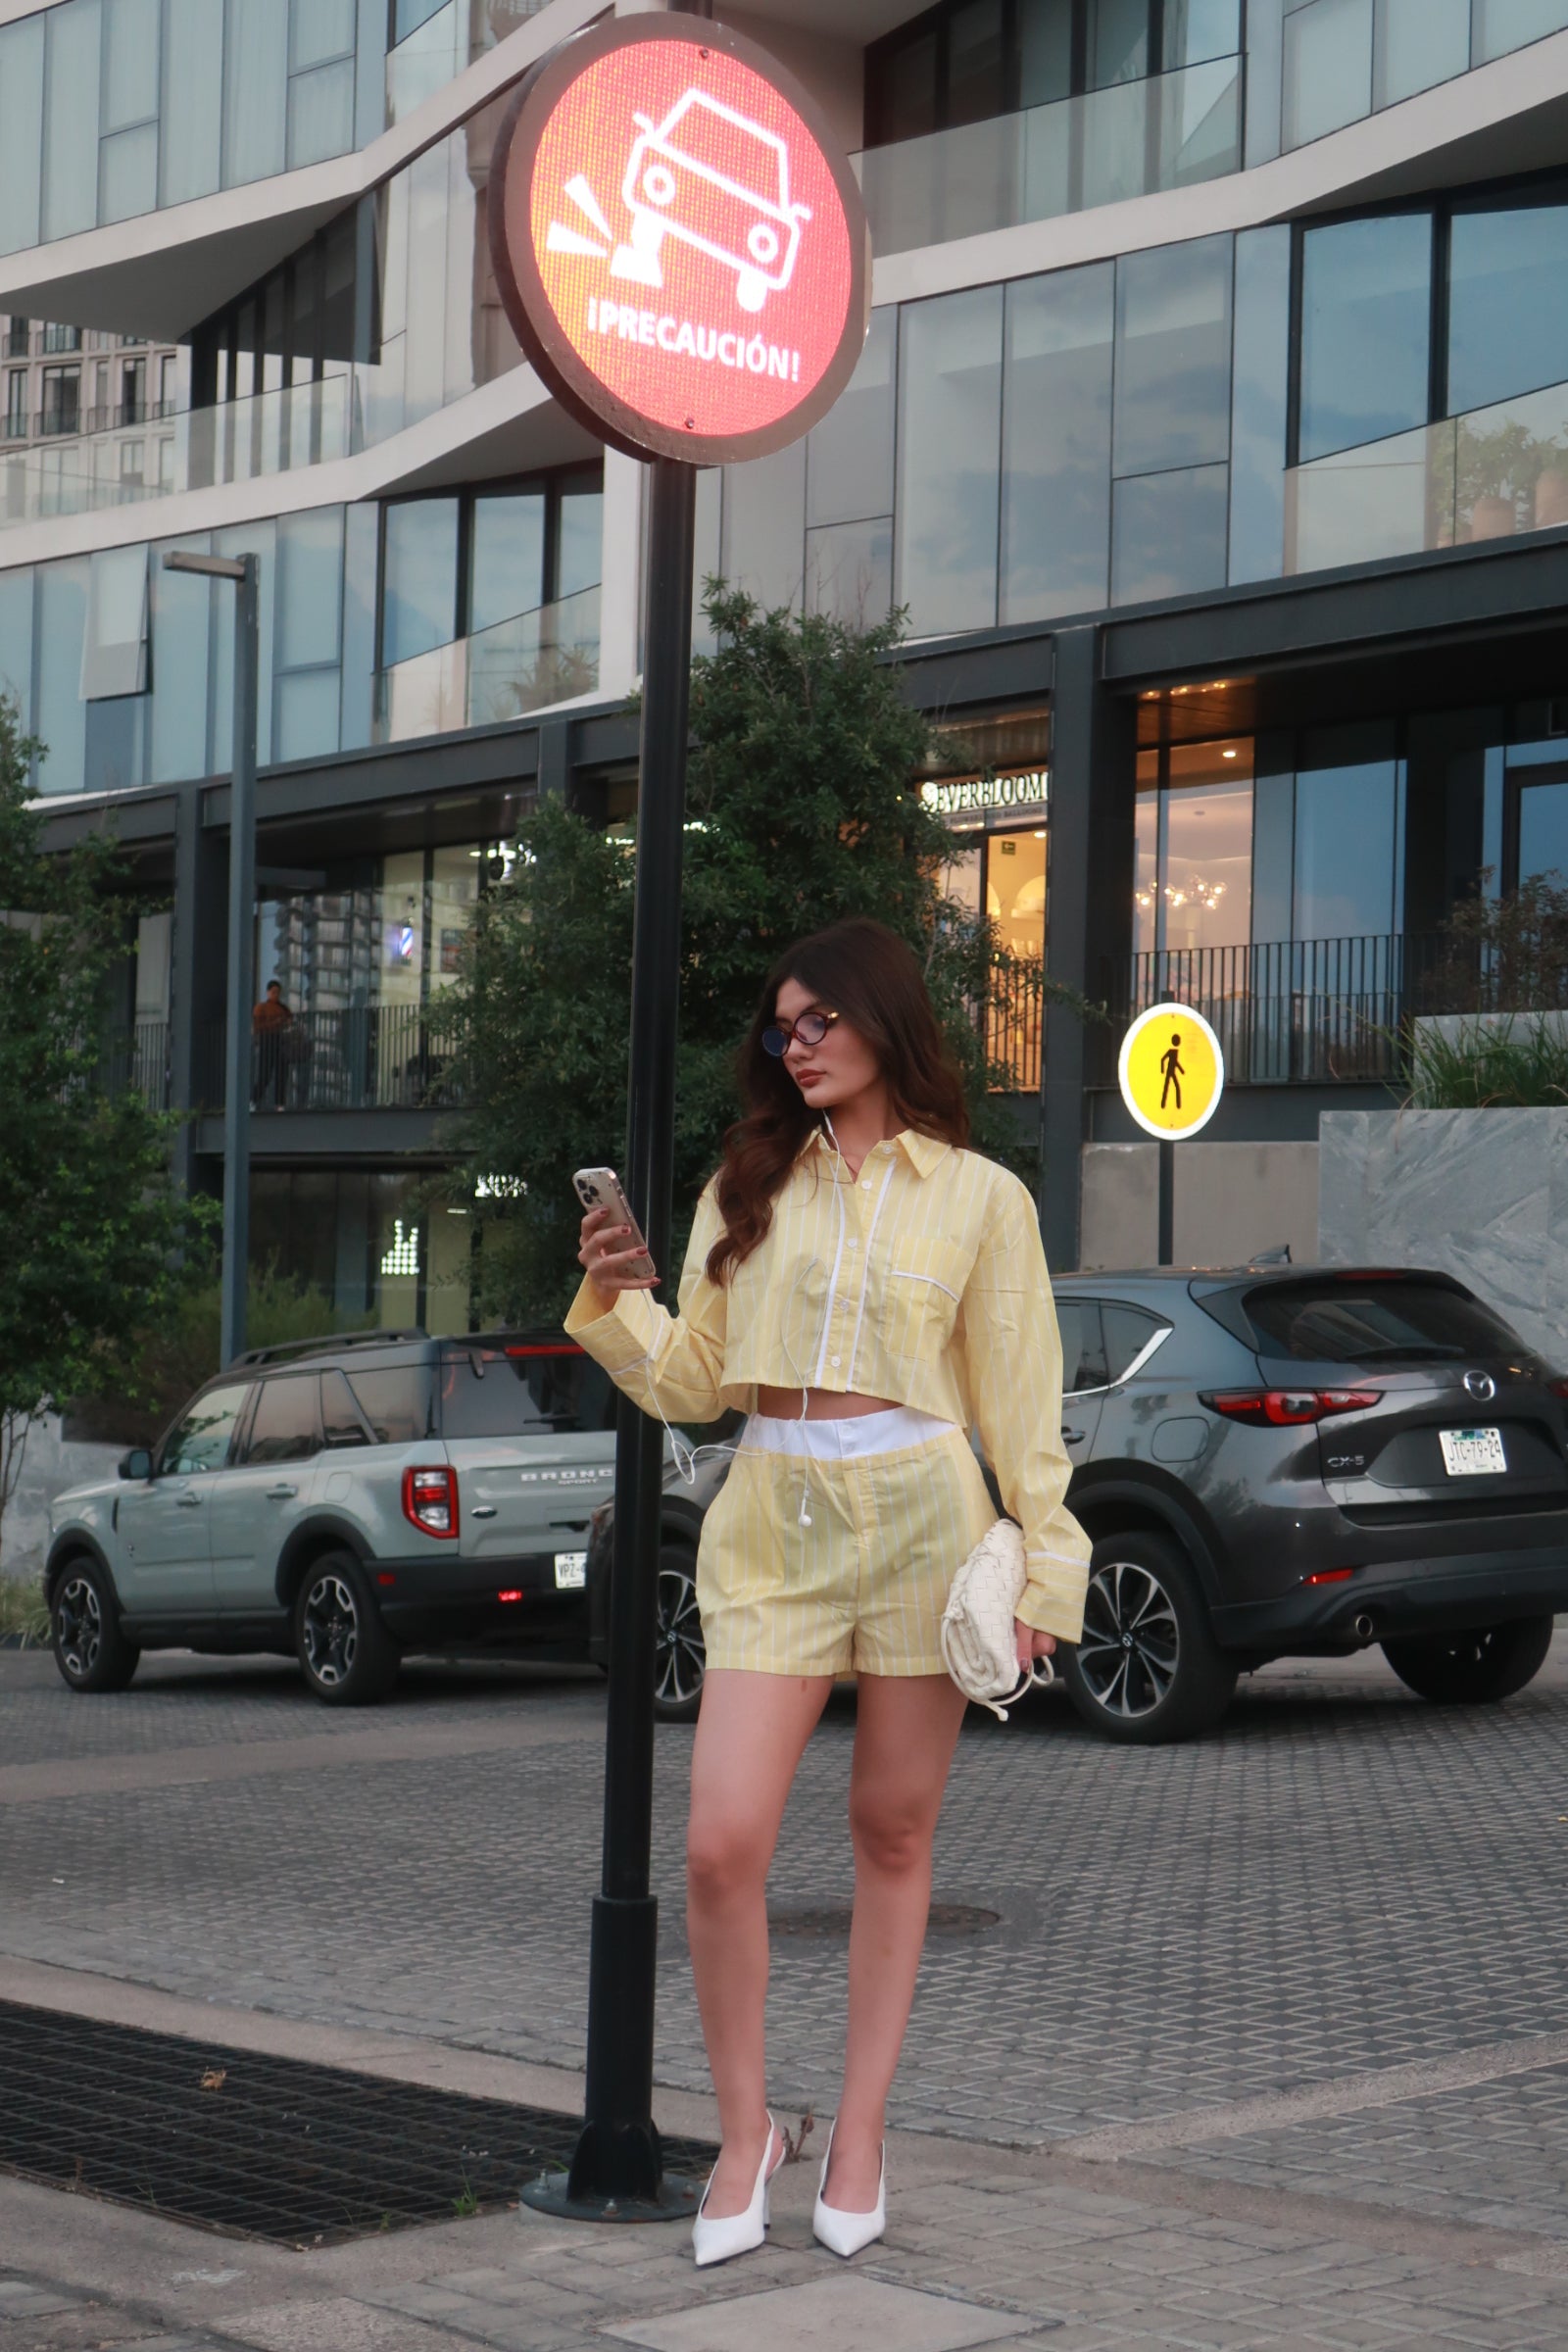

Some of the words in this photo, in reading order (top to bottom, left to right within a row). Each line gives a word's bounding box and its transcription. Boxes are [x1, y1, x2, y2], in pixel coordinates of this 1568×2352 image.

[588, 297, 800, 382] ¡PRECAUCIÓN!
[937, 772, 1047, 811] EVERBLOOM
[1449, 1440, 1501, 1461] JTC-79-24
[1327, 1455, 1365, 1468] CX-5
[520, 1469, 613, 1482] BRONC
